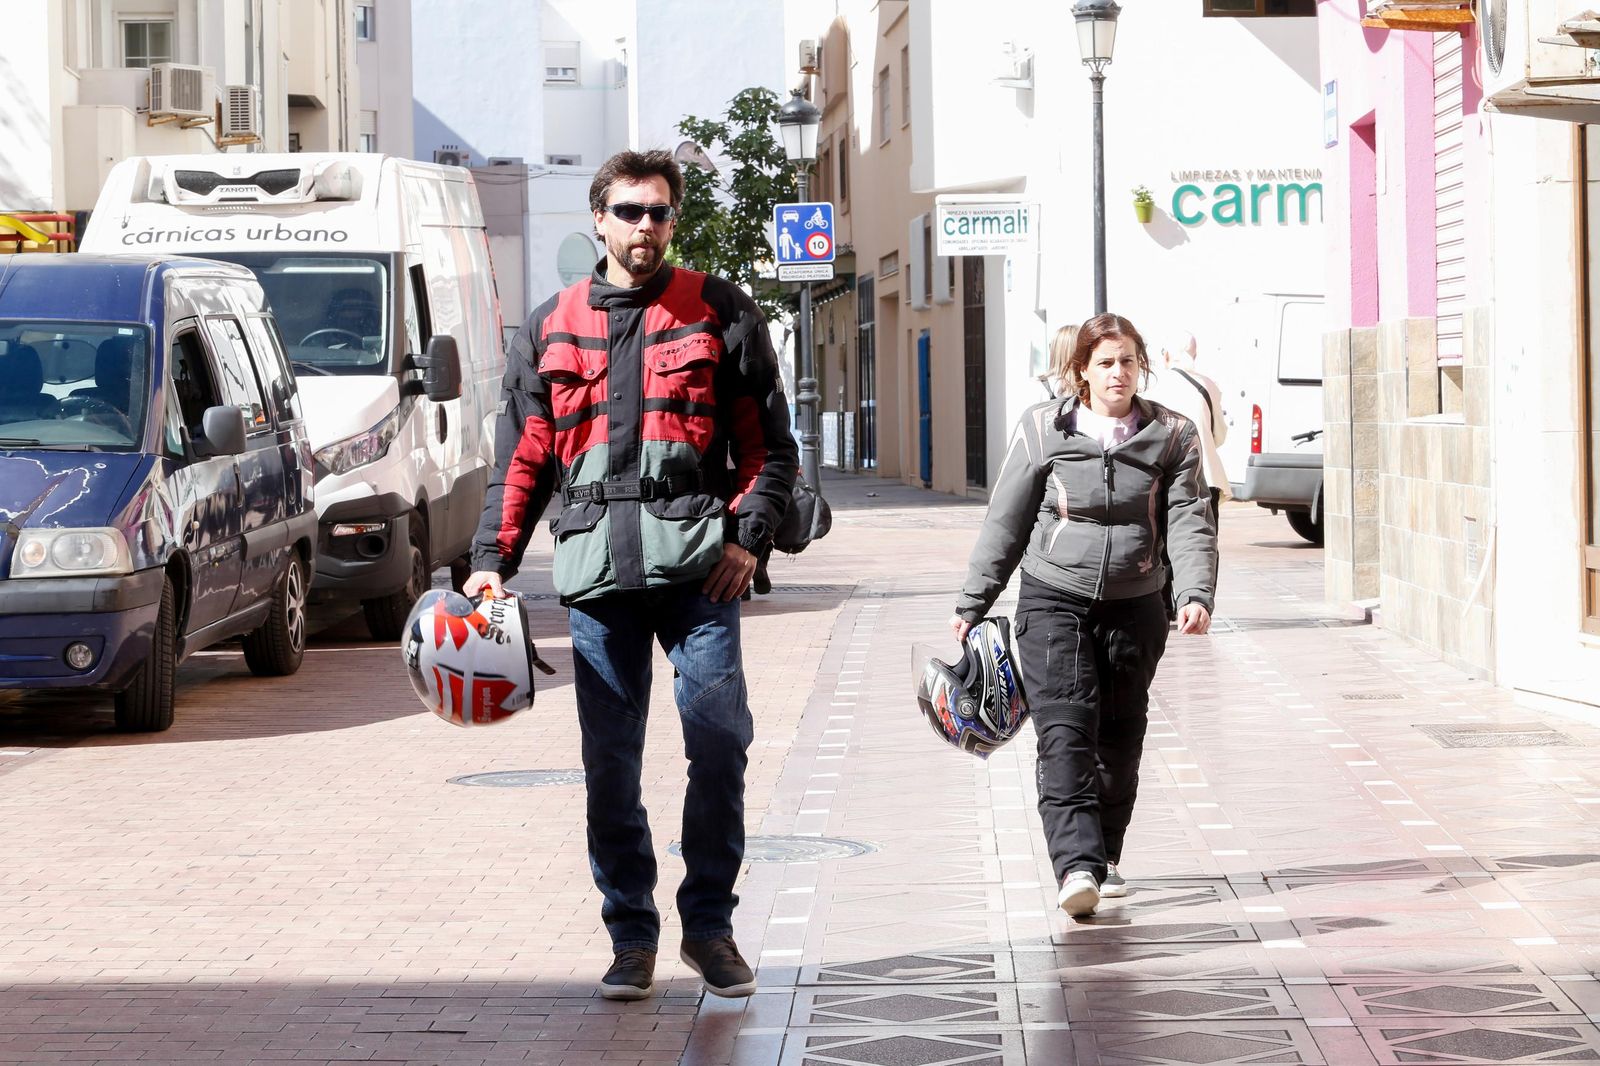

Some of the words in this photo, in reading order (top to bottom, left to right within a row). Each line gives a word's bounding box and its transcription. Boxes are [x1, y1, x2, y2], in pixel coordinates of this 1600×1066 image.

[1171, 170, 1239, 181] LIMPIEZAS
[1245, 169, 1254, 180] Y
[943, 208, 1028, 236] carmali
[122, 226, 236, 245] cárnicas
[246, 223, 348, 242] urbano
[813, 241, 825, 249] 10
